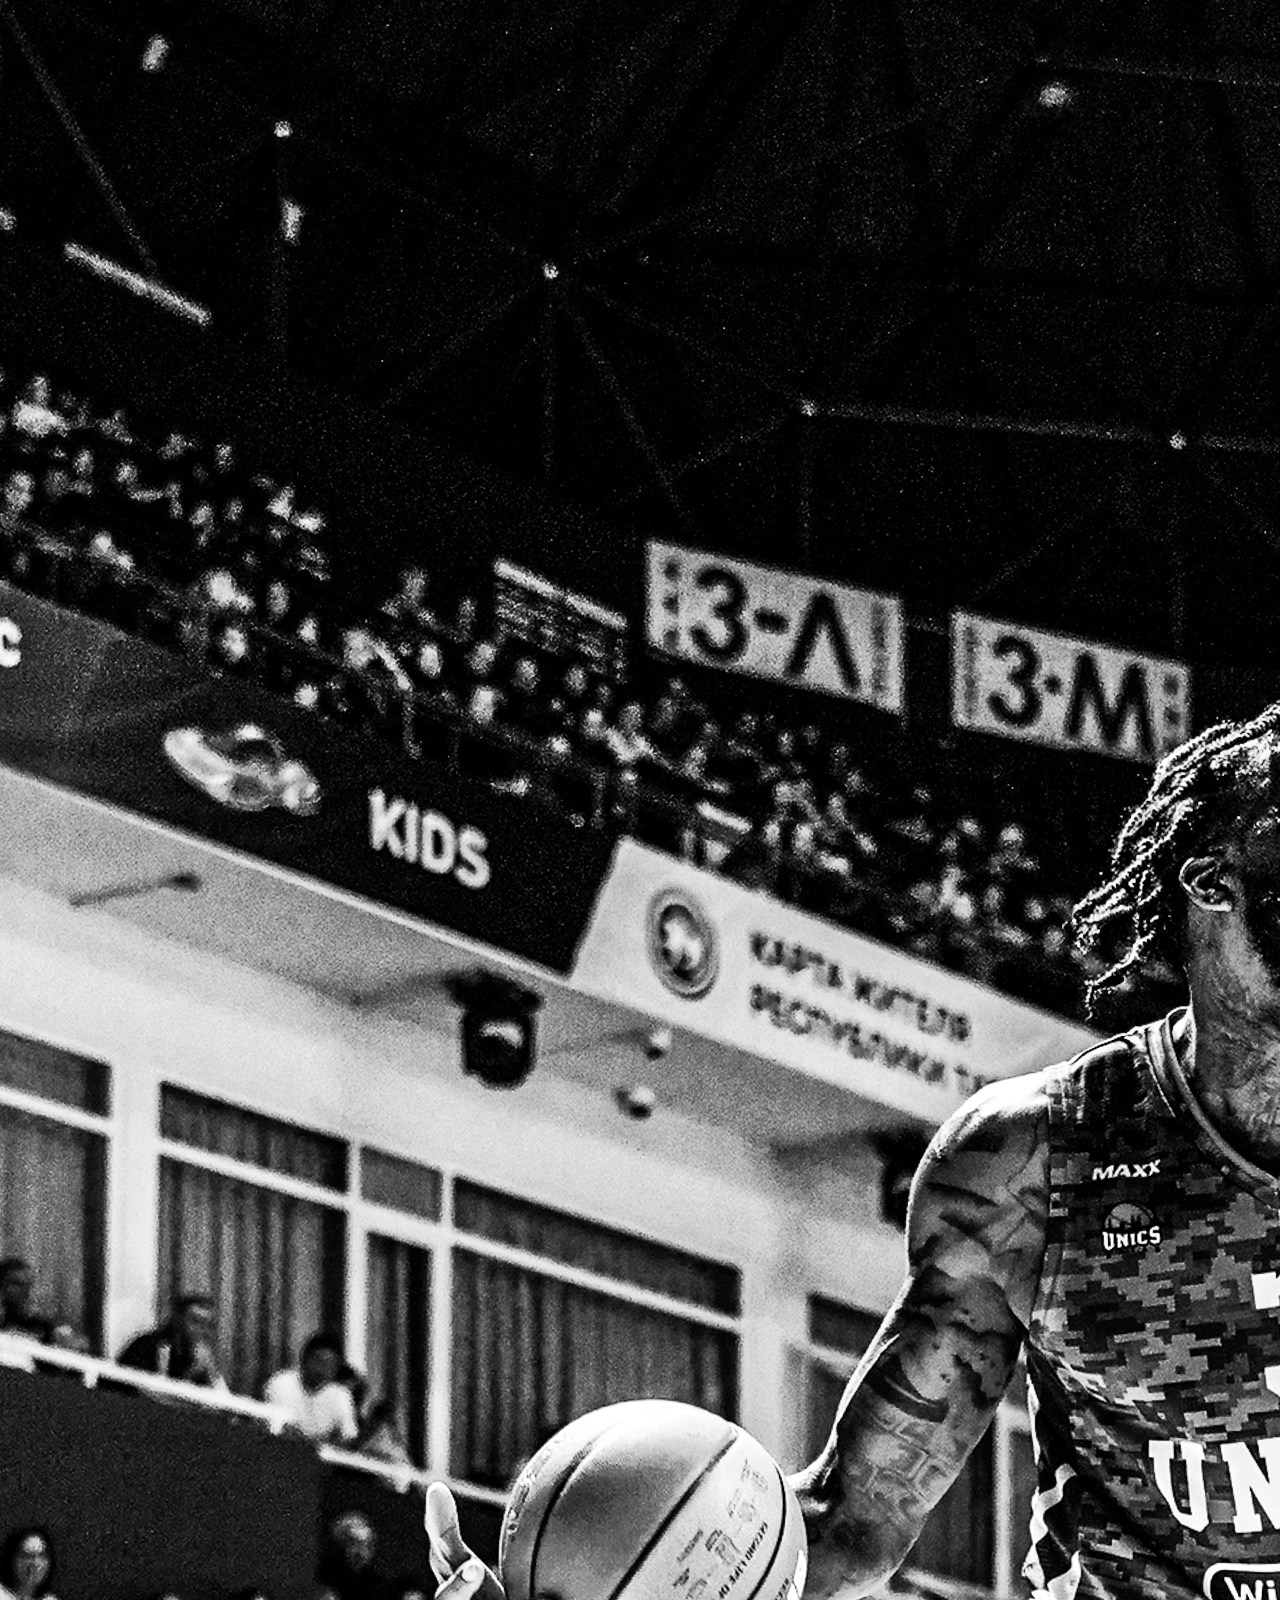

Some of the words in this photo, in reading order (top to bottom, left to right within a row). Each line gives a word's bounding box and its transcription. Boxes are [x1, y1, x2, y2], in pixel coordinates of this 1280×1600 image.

[367, 788, 491, 889] KIDS
[1091, 1158, 1161, 1181] MAXX
[1101, 1225, 1161, 1251] UNICS
